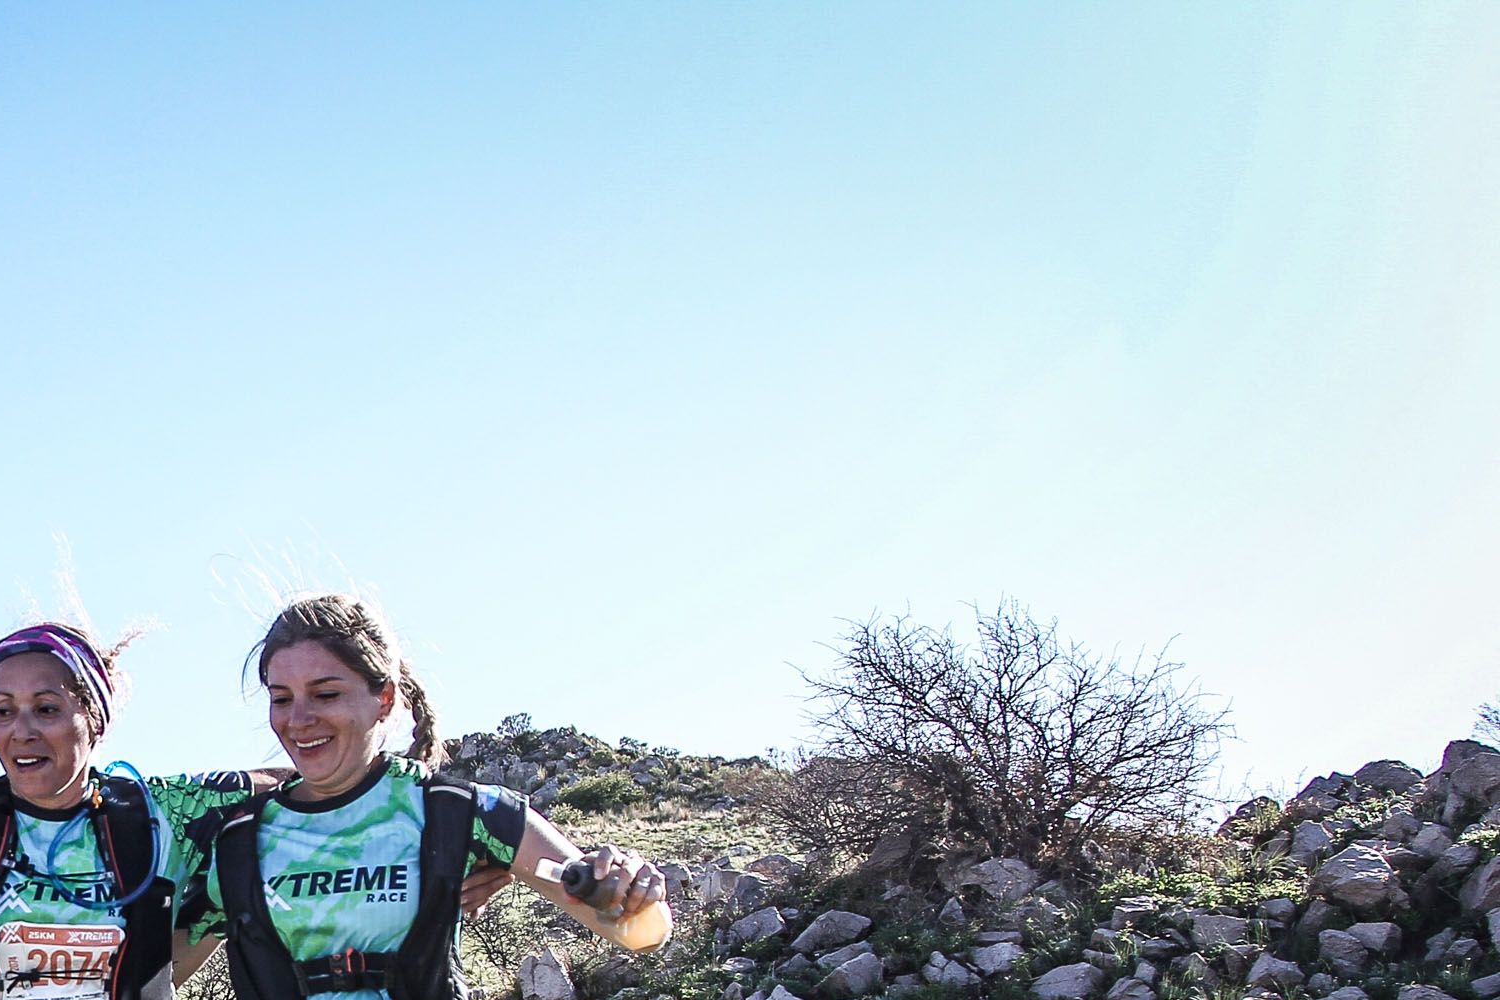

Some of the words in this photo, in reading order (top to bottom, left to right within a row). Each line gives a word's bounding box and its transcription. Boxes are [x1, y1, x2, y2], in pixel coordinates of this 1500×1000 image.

[366, 893, 407, 903] RACE
[28, 931, 56, 940] 25KM
[67, 930, 113, 943] XTREME
[28, 949, 112, 987] 2074
